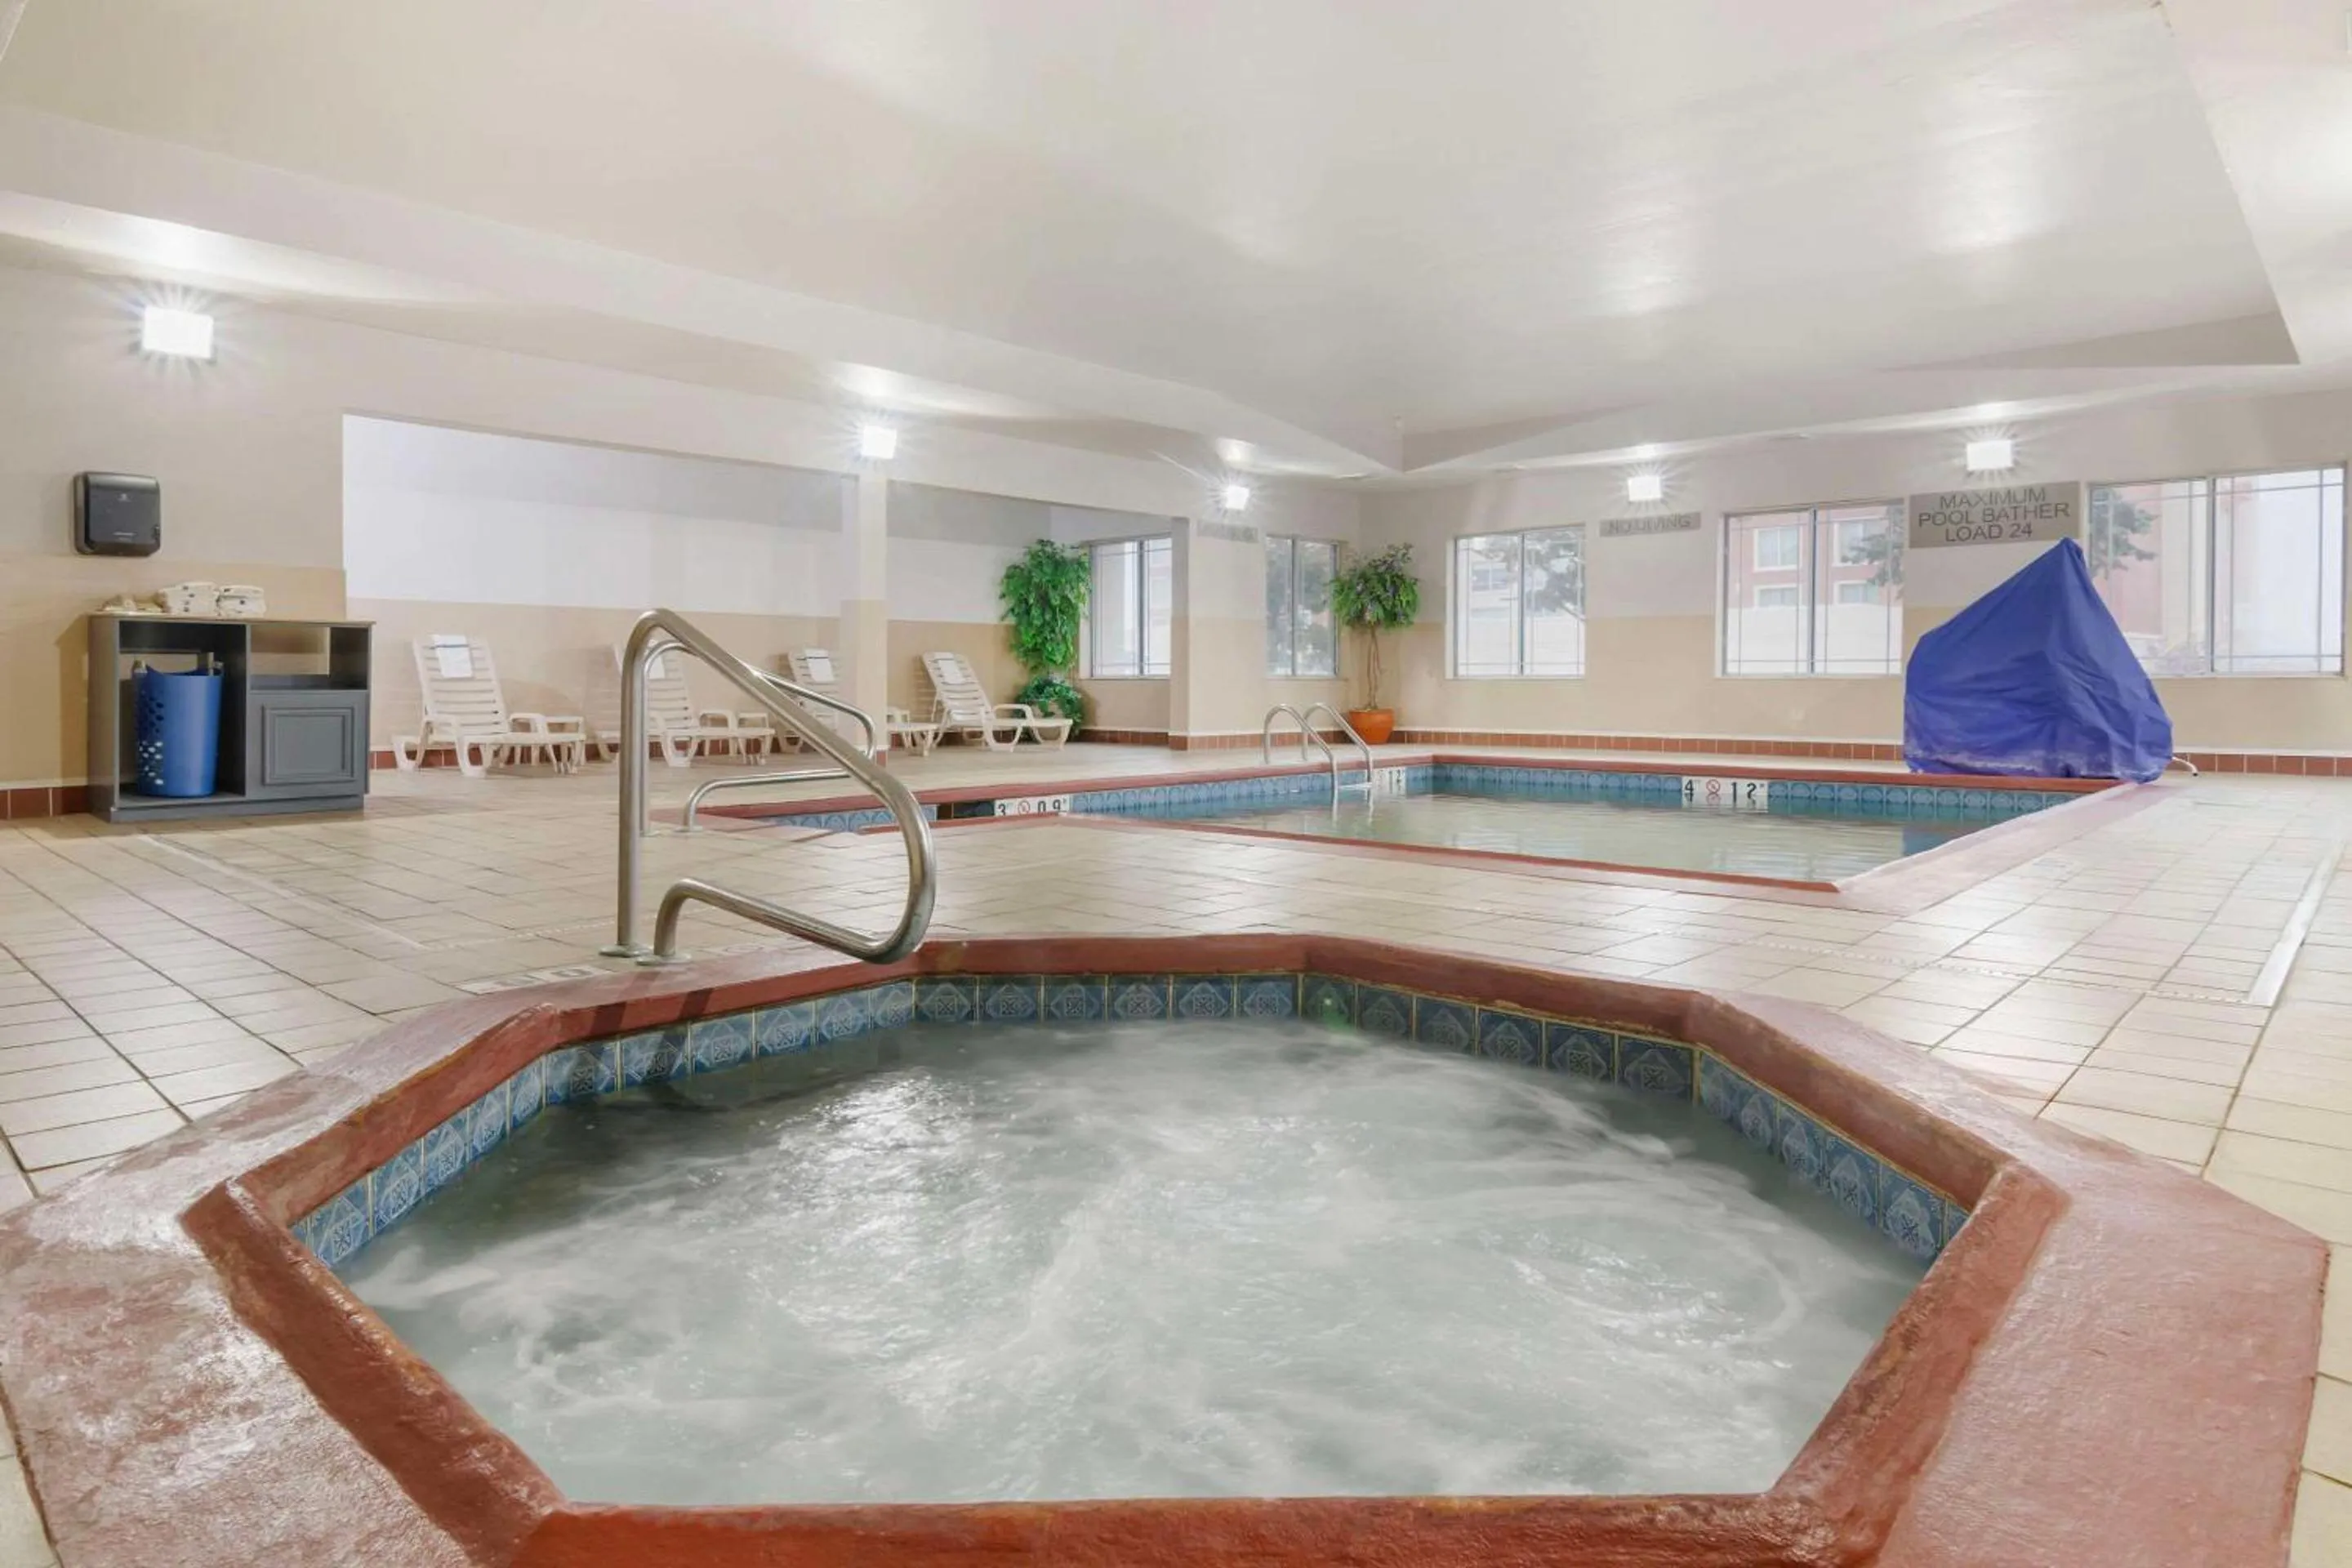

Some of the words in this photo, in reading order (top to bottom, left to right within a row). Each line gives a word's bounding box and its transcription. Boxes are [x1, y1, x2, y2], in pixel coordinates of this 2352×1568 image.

[1939, 488, 2046, 510] MAXIMUM
[1918, 510, 1976, 528] POOL
[1982, 502, 2070, 523] BATHER
[1945, 525, 2003, 542] LOAD
[2009, 523, 2033, 538] 24
